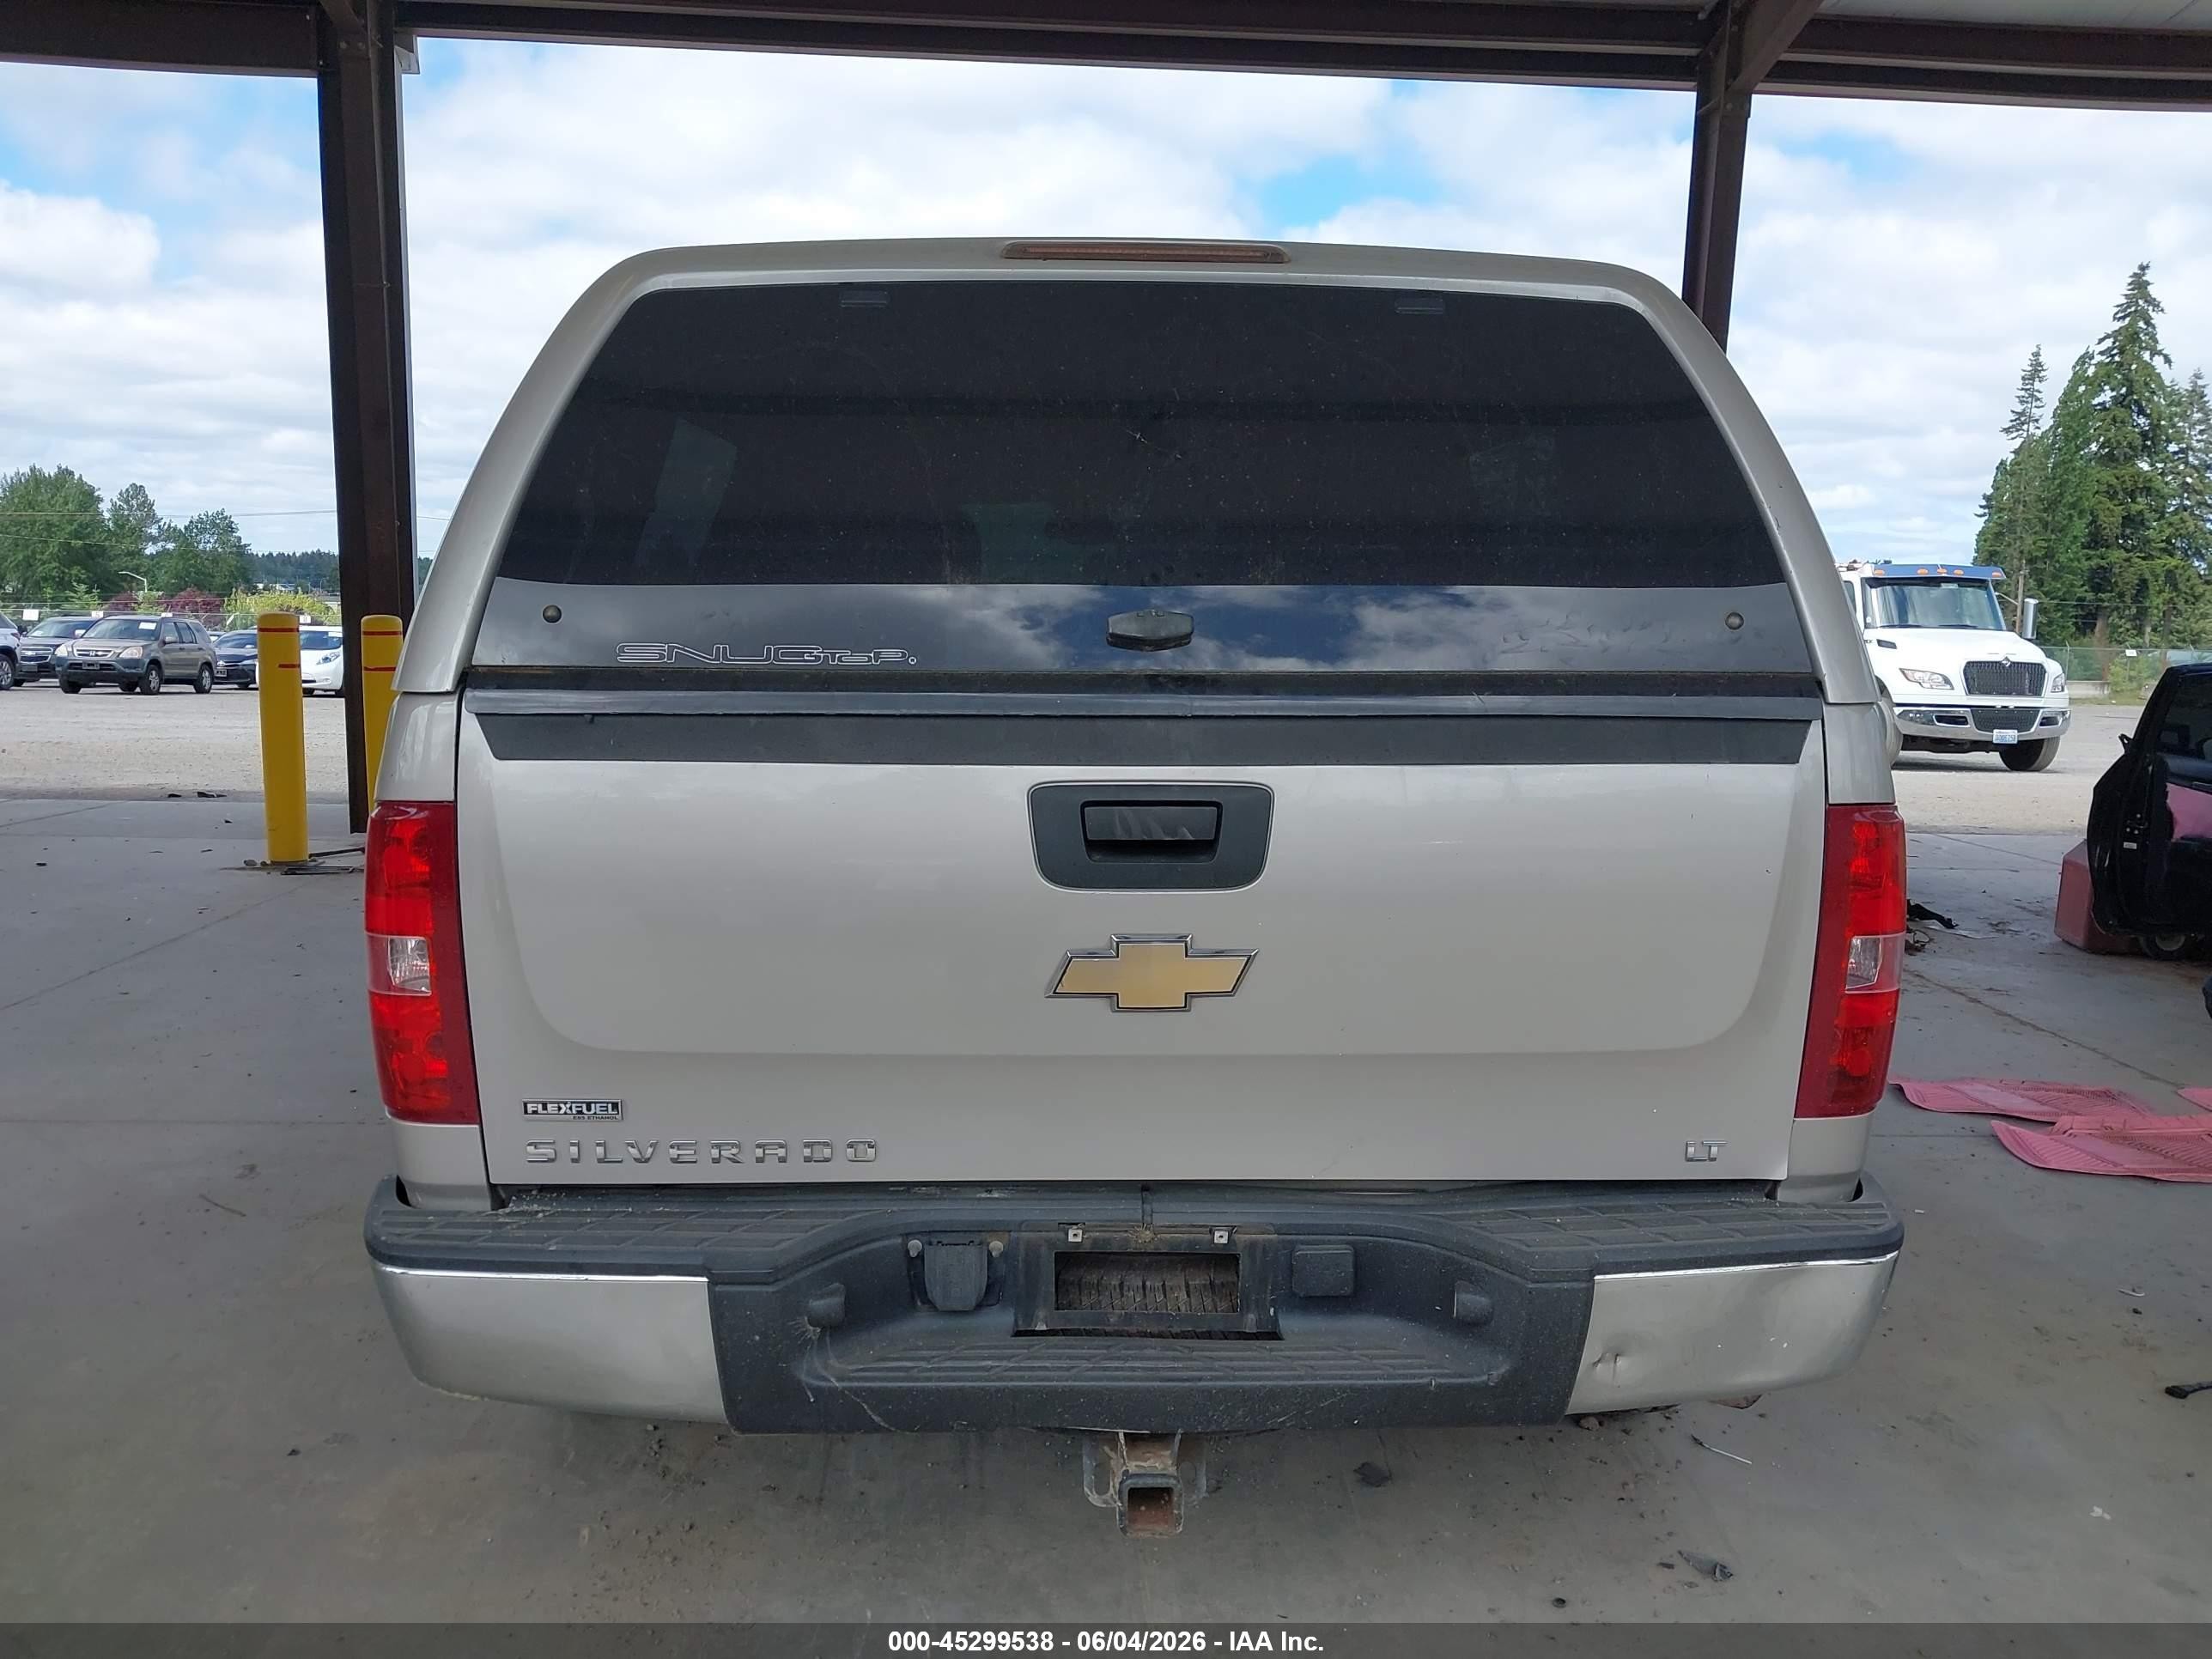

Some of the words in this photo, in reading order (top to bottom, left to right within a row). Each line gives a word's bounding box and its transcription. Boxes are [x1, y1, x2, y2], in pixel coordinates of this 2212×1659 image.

[526, 1102, 618, 1115] FLEXFUEL
[525, 1139, 878, 1164] SILVERADO
[1685, 1139, 1728, 1162] LT
